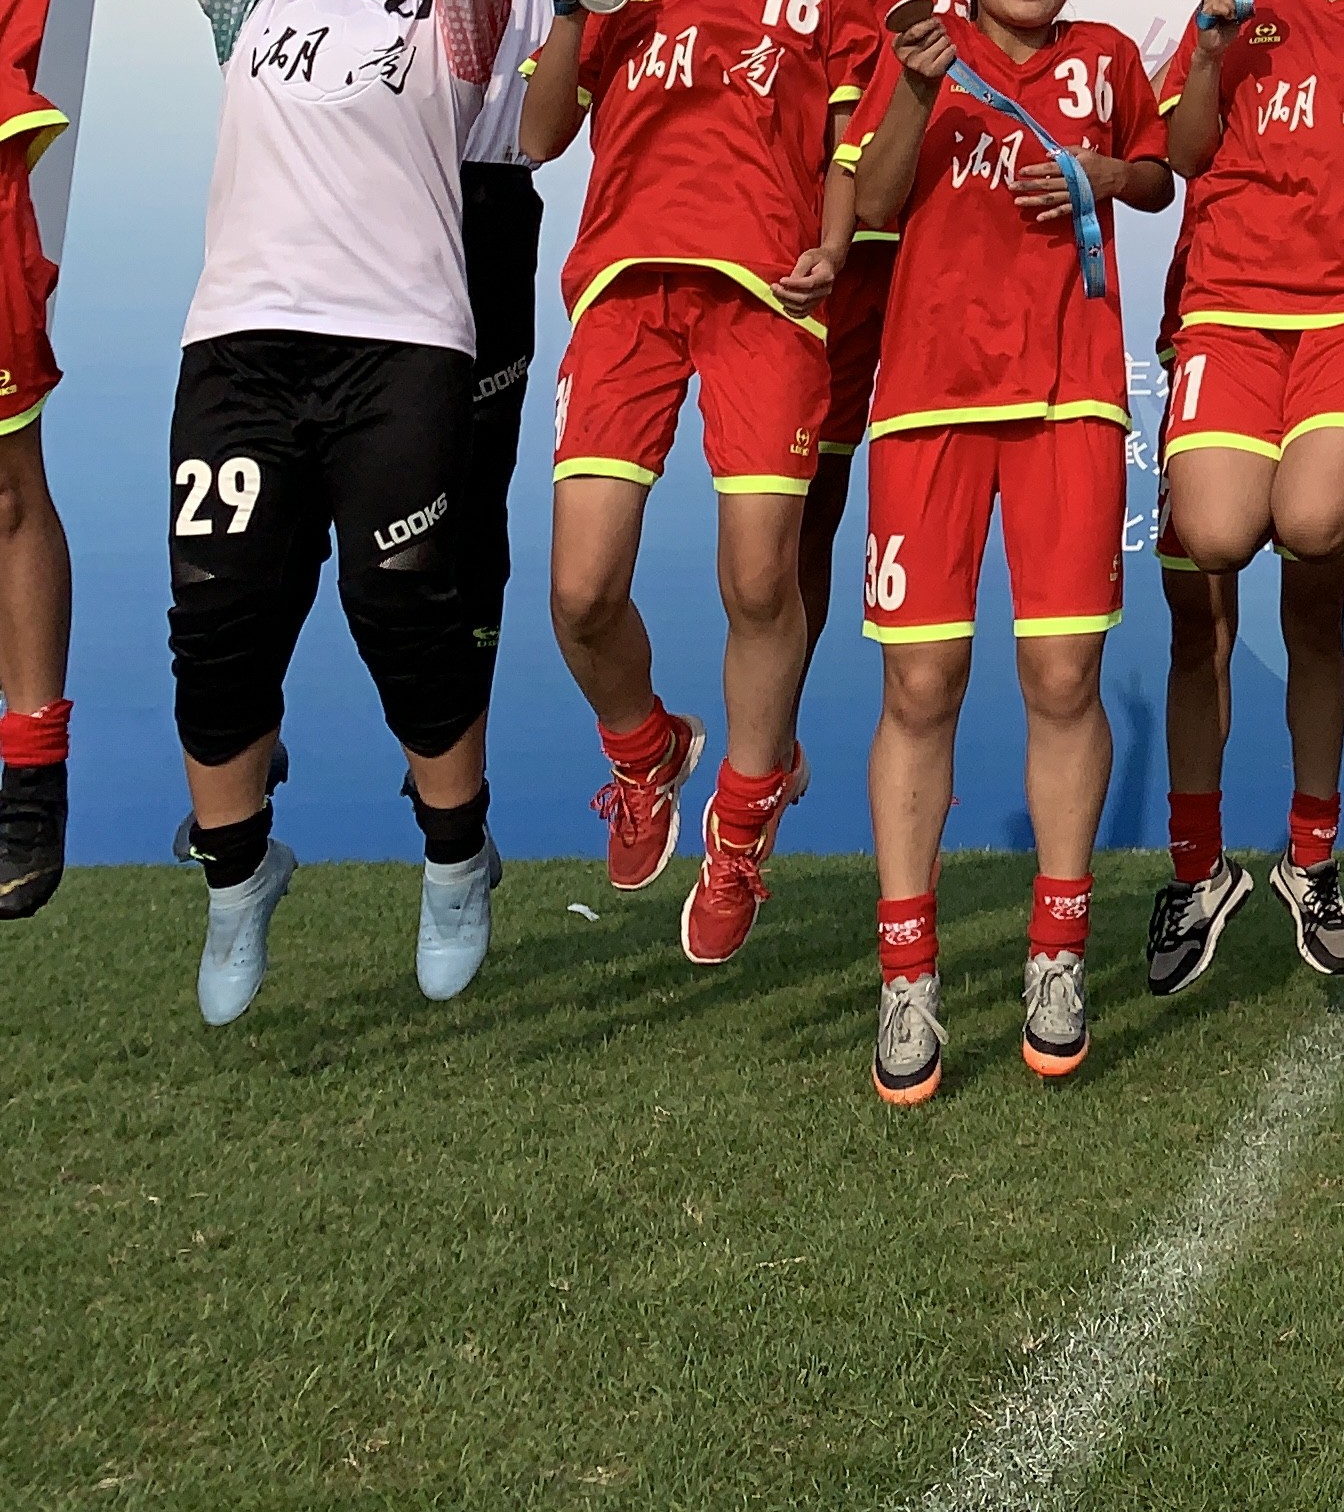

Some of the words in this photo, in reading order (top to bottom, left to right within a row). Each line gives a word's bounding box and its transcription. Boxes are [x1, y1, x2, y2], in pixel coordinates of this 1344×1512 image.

[250, 26, 418, 96] 湖南
[627, 26, 786, 98] 湖南
[1053, 55, 1114, 124] 36
[174, 456, 262, 537] 29
[373, 491, 449, 551] LOOKS
[865, 535, 907, 611] 36
